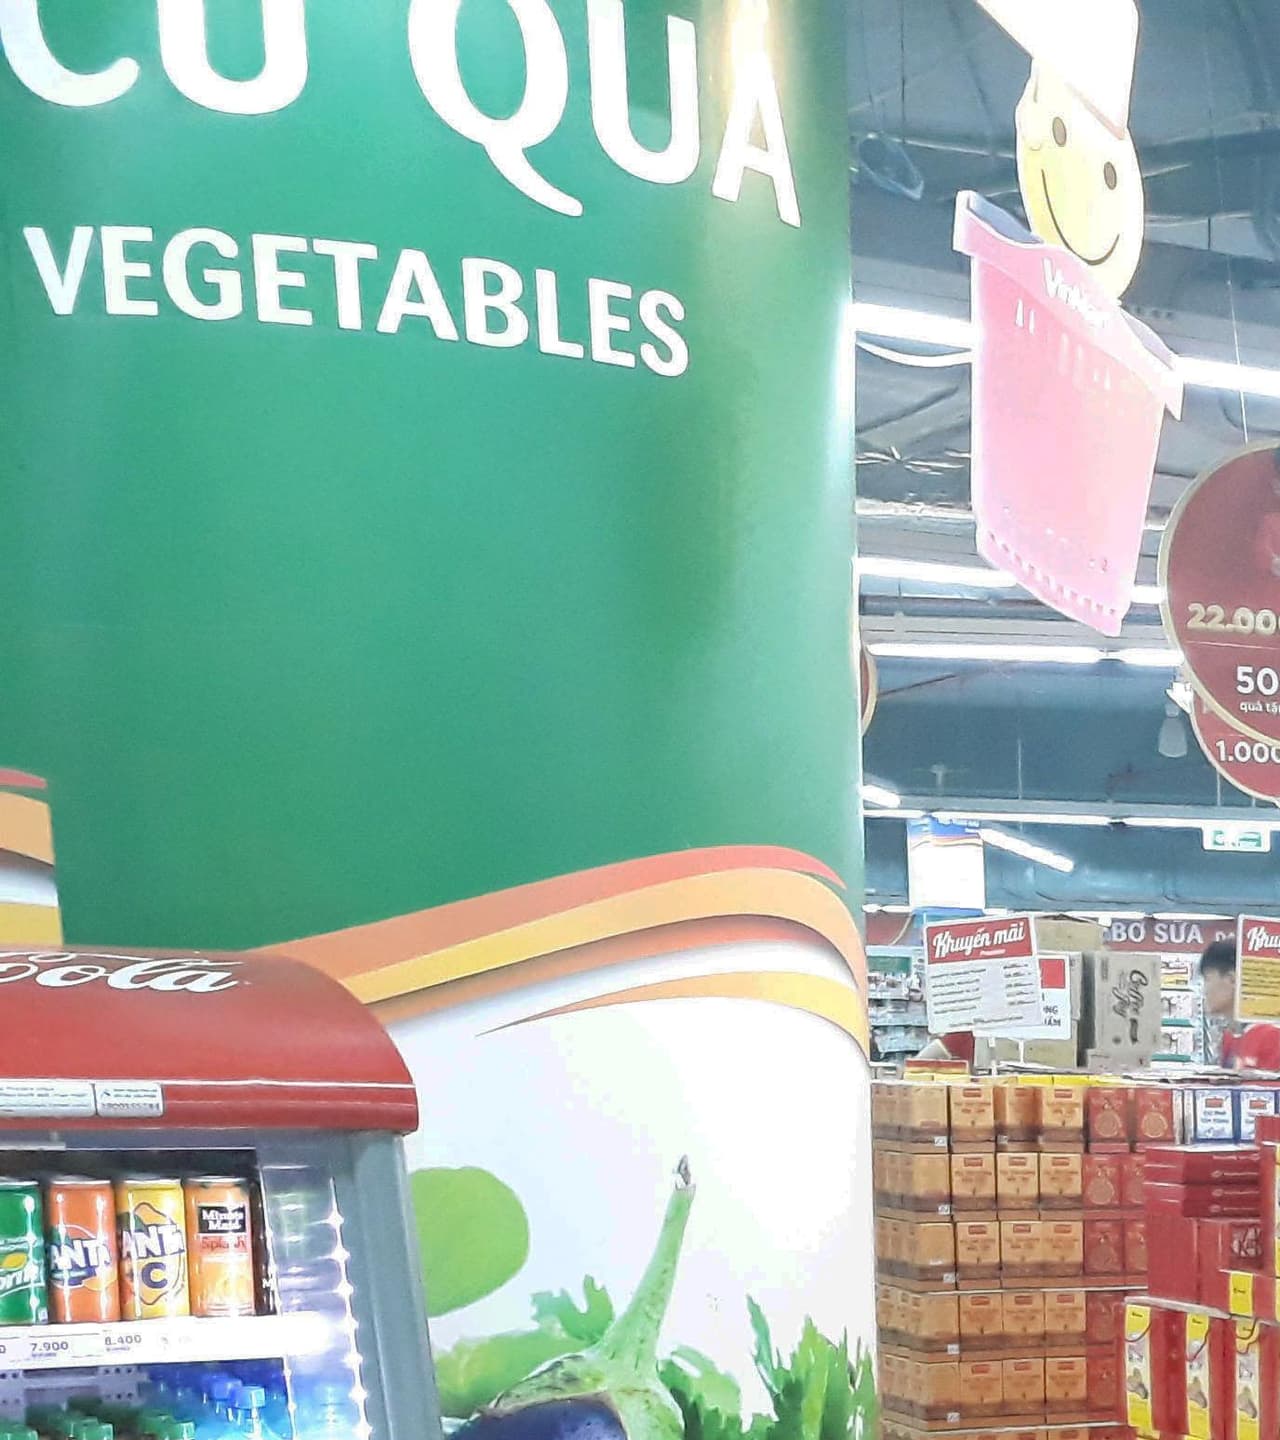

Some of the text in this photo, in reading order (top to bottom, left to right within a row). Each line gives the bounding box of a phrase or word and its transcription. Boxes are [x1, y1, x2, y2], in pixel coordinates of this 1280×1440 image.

[22, 225, 691, 378] VEGETABLES
[1236, 665, 1279, 696] 50
[932, 921, 1026, 959] Khuyến mãi
[141, 1262, 168, 1289] C
